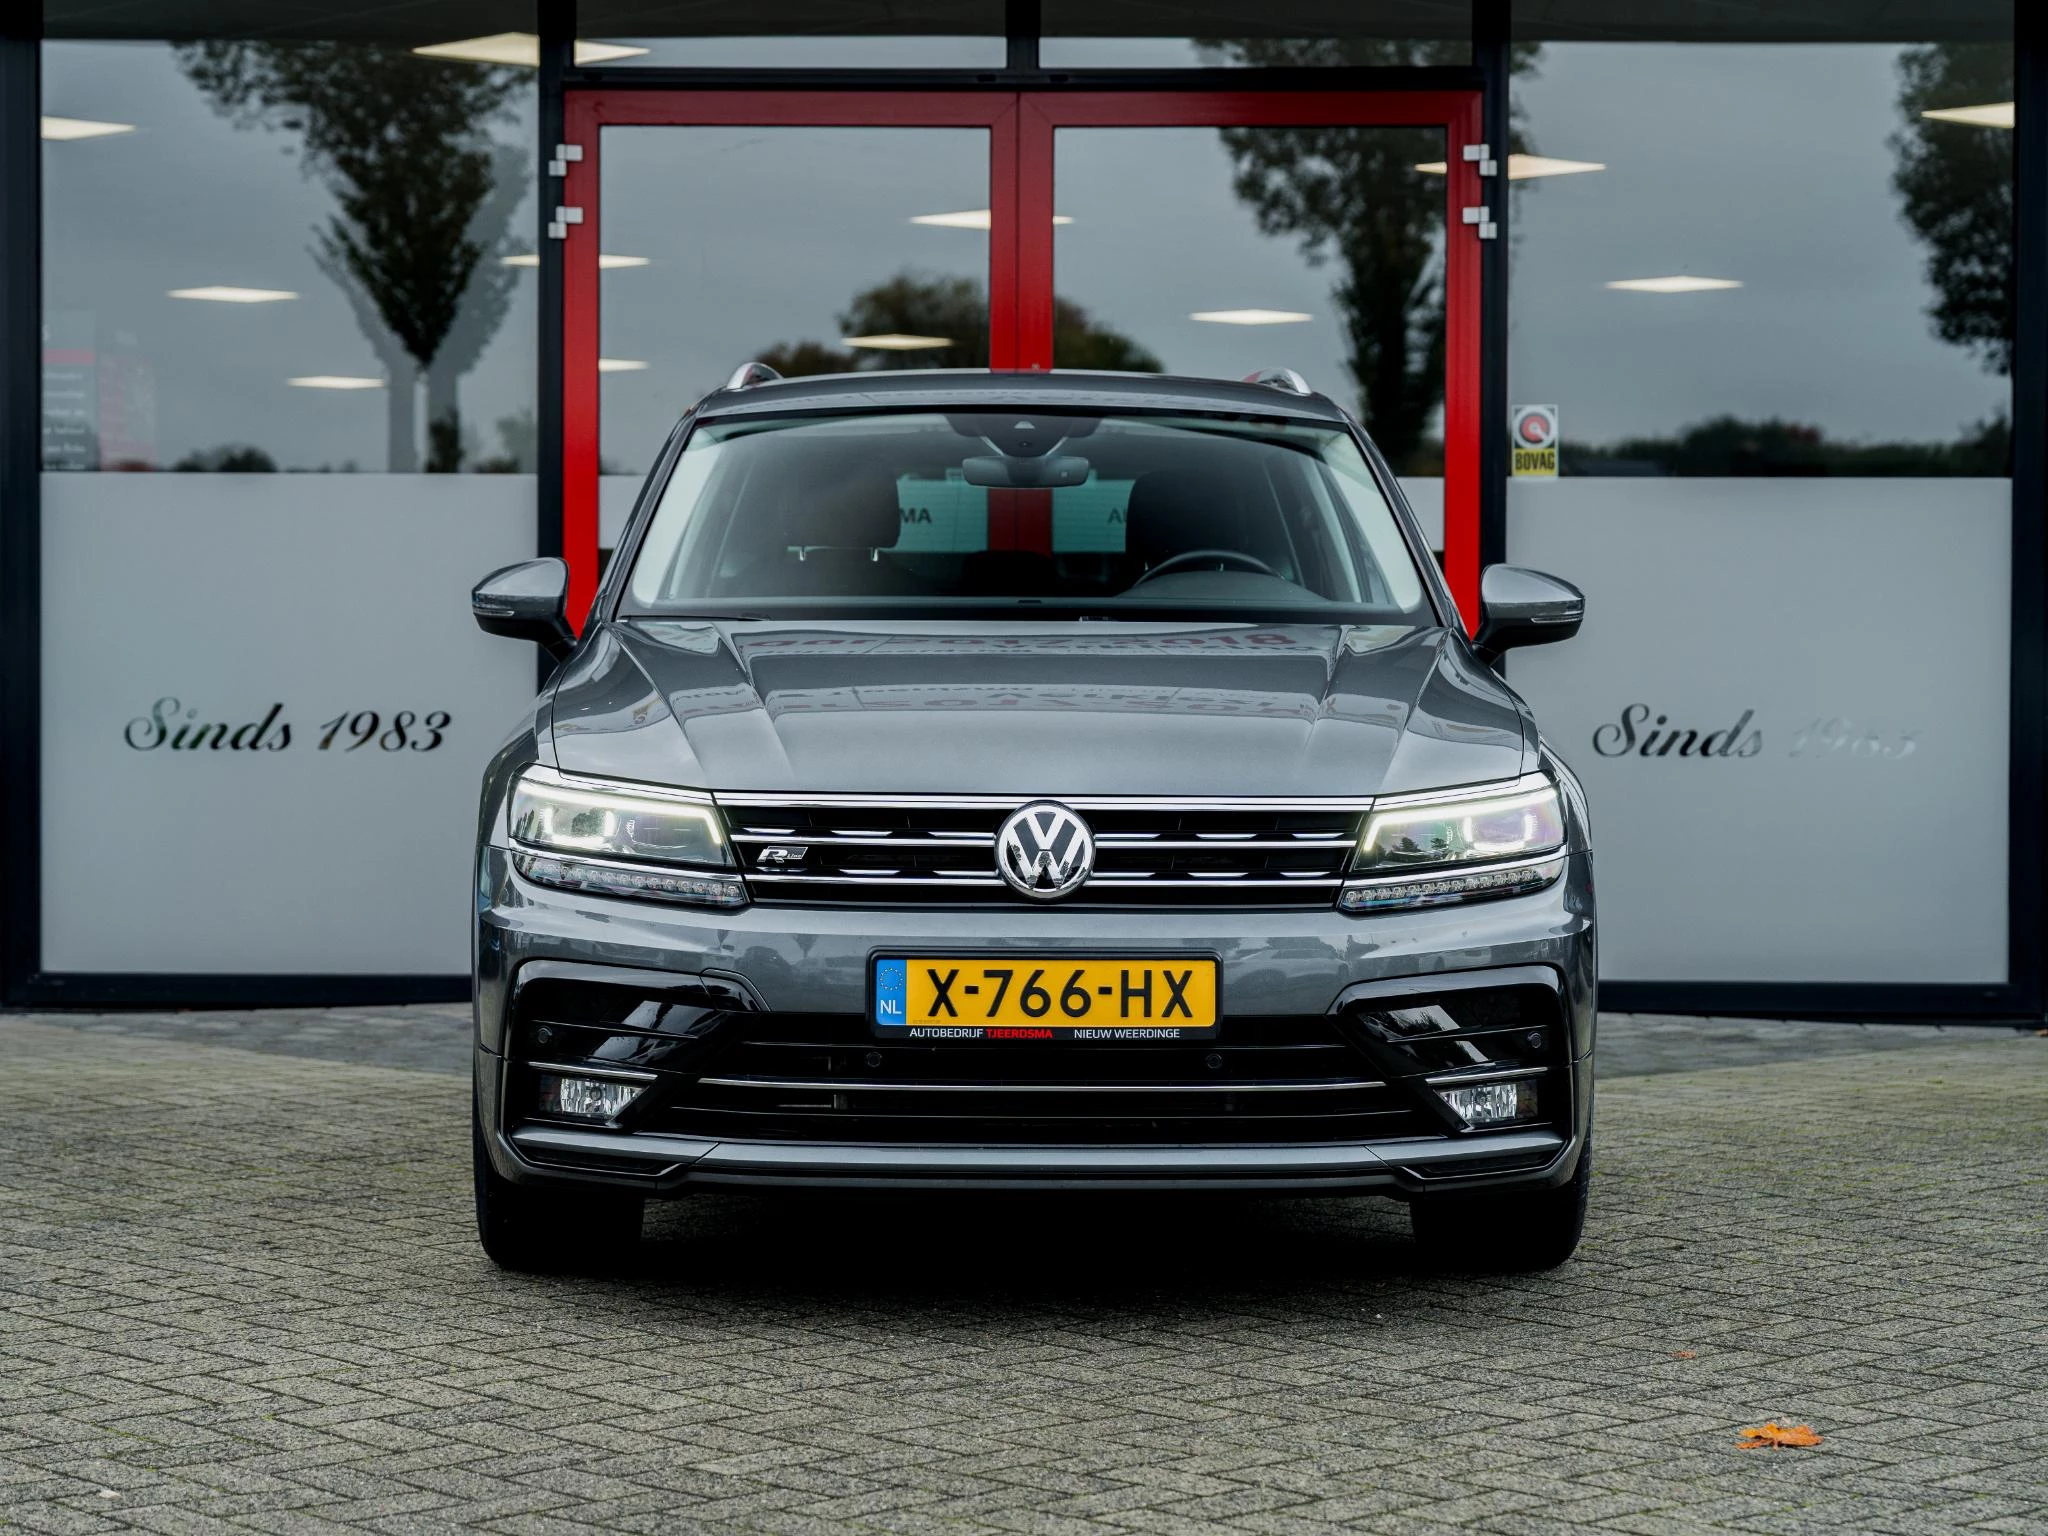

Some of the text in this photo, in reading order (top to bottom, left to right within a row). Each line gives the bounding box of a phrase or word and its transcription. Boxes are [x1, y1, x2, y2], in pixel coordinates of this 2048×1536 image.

[1515, 451, 1556, 471] BOVAG
[124, 697, 452, 752] Sinds 1983
[1593, 703, 1763, 758] Sinds
[880, 969, 1193, 1018] NL X-766-HX
[909, 1027, 1181, 1040] AUTOBEDRIJF TJEERDSMA NIEUW WEERDINGE
